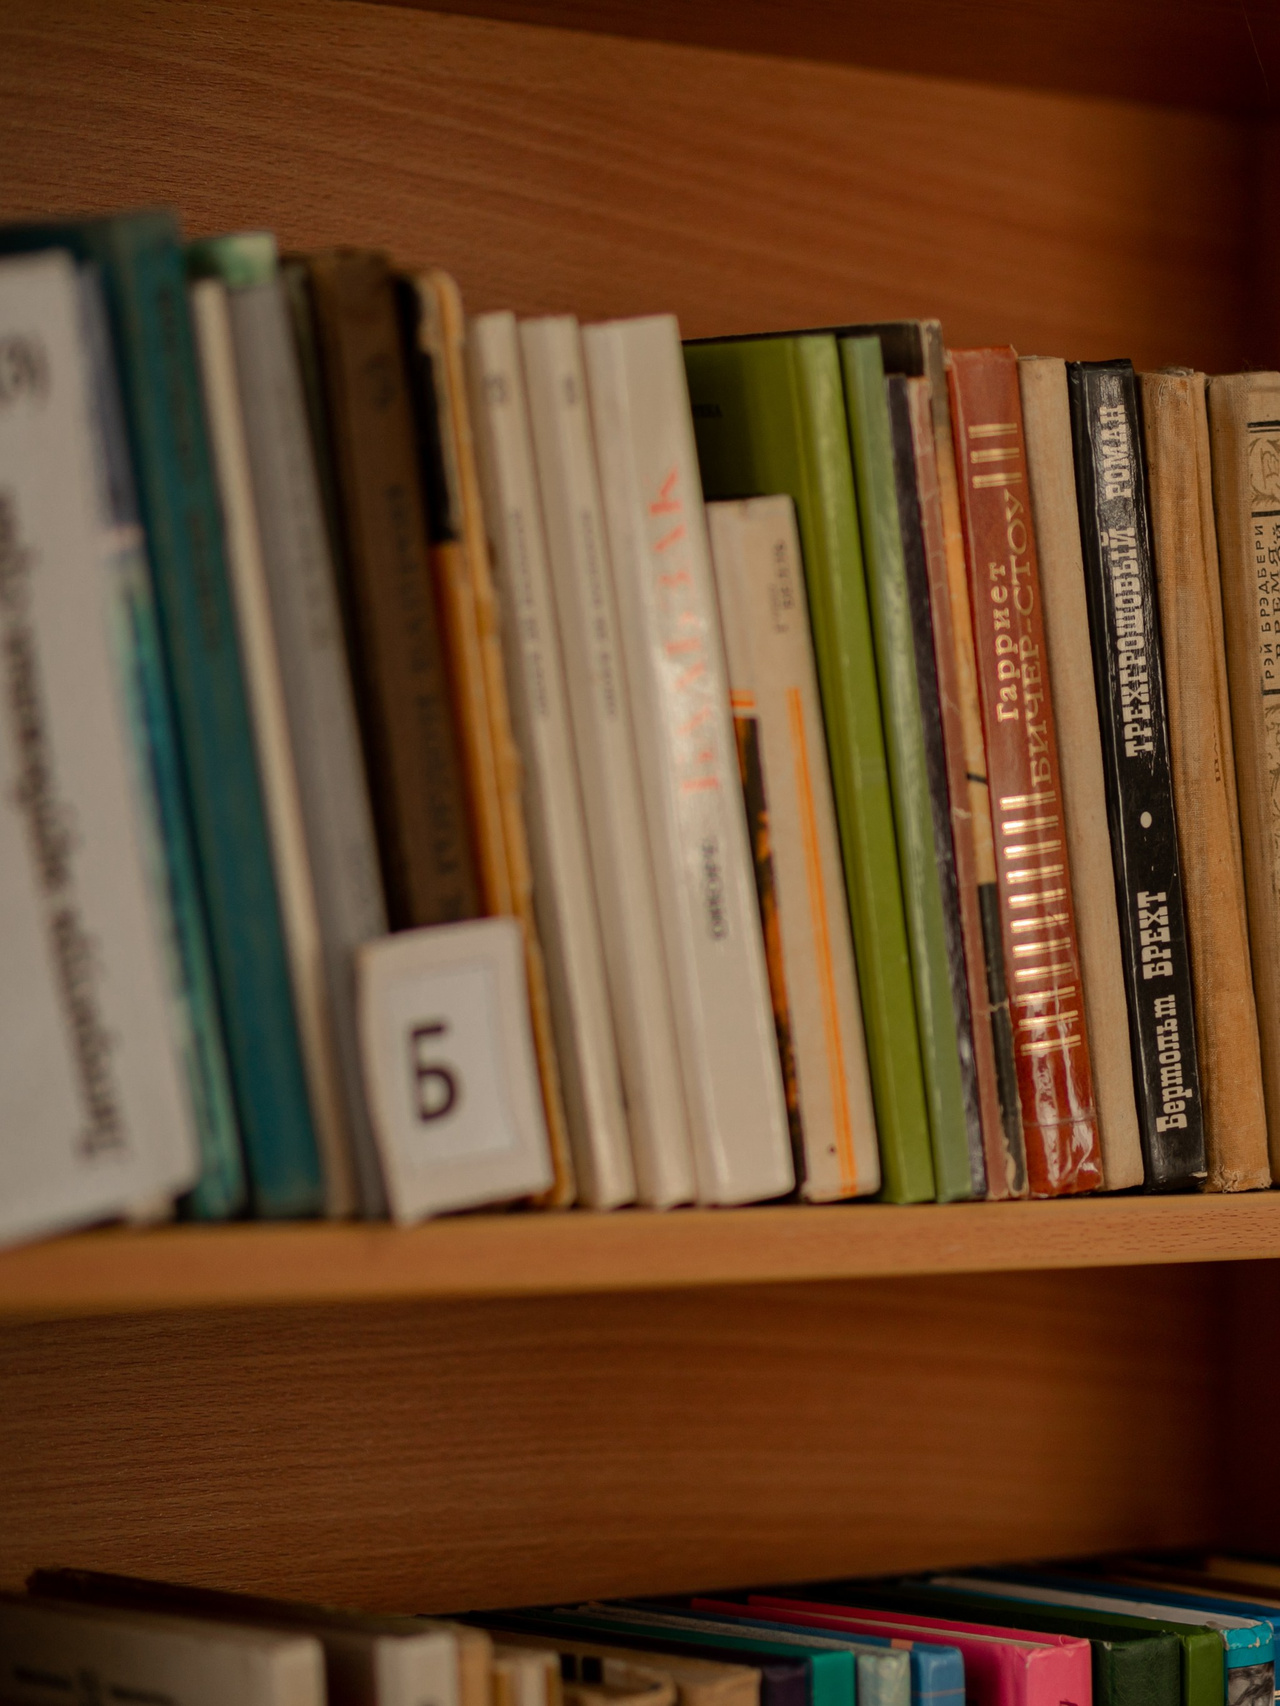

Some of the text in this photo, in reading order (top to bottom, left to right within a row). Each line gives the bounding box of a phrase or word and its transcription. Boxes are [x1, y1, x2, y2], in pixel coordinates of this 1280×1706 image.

[988, 561, 1020, 723] Гарриет
[1004, 488, 1053, 788] БИЧЕР-СТОУ
[1254, 524, 1275, 680] РЭЙ БРЭДБЕРИ
[1099, 404, 1193, 1133] Бертольт БРЕХТ ТРЕХГРОШОВЫЙ РОМАН
[409, 1019, 461, 1125] Б
